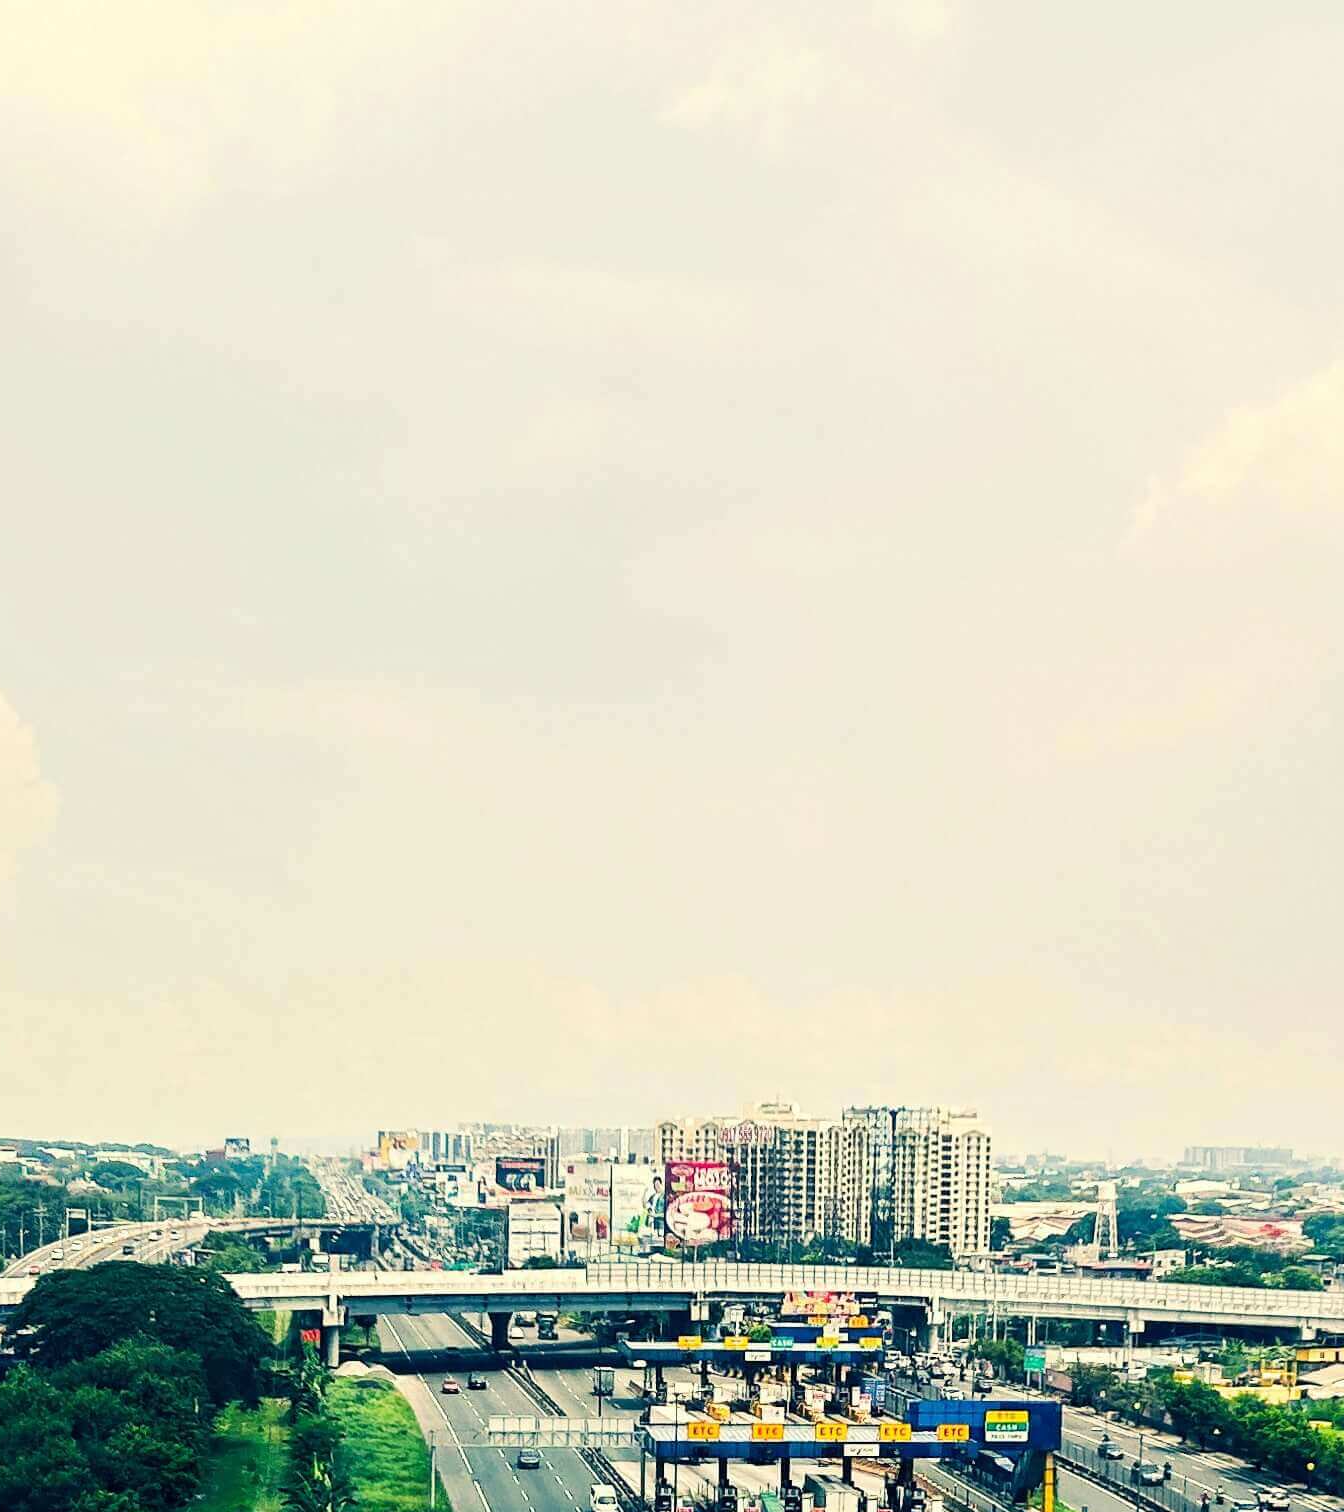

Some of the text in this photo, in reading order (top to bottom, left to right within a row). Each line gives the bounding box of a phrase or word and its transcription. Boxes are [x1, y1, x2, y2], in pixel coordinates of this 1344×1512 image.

[693, 1427, 714, 1436] ETC
[757, 1427, 779, 1436] ETC
[820, 1427, 843, 1436] ETC
[884, 1428, 906, 1437] ETC
[943, 1428, 964, 1437] ETC
